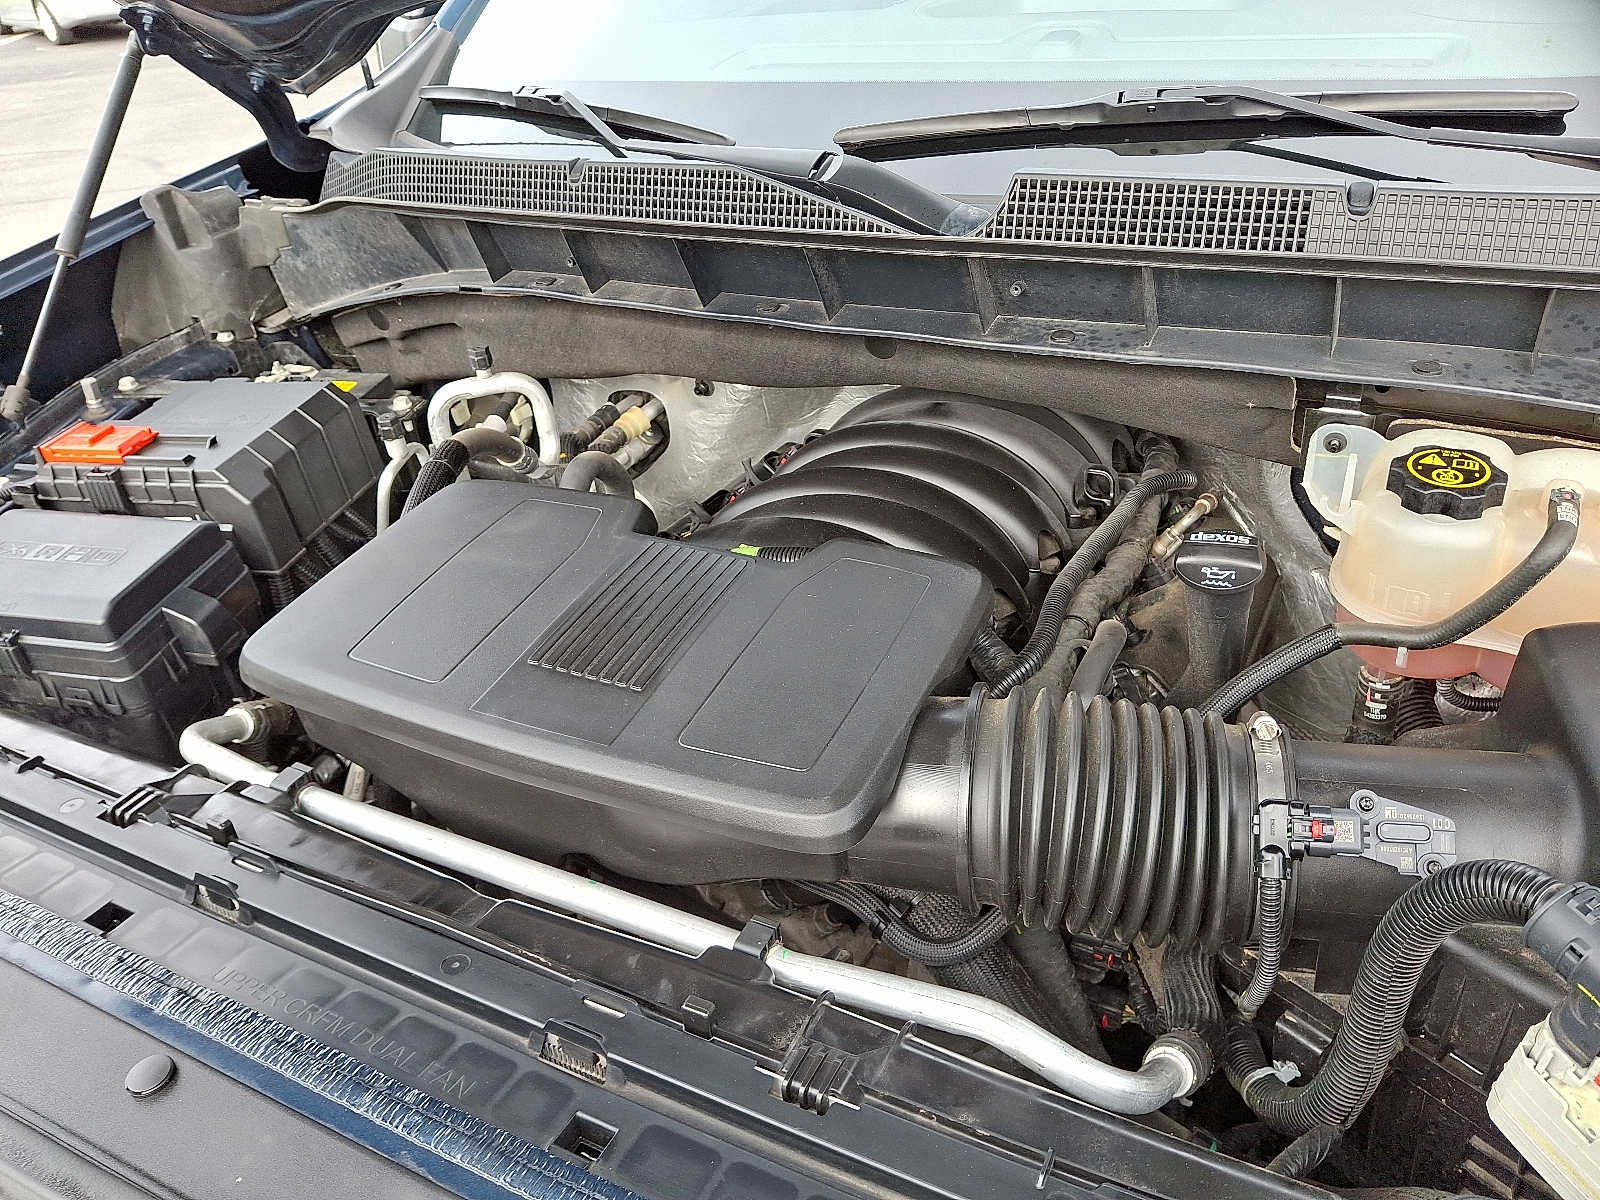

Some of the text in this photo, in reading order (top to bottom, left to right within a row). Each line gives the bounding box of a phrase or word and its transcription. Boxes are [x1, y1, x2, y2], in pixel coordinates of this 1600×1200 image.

[1190, 532, 1250, 545] dexos
[213, 966, 477, 1099] UPPER CRFM DUAL FAN
